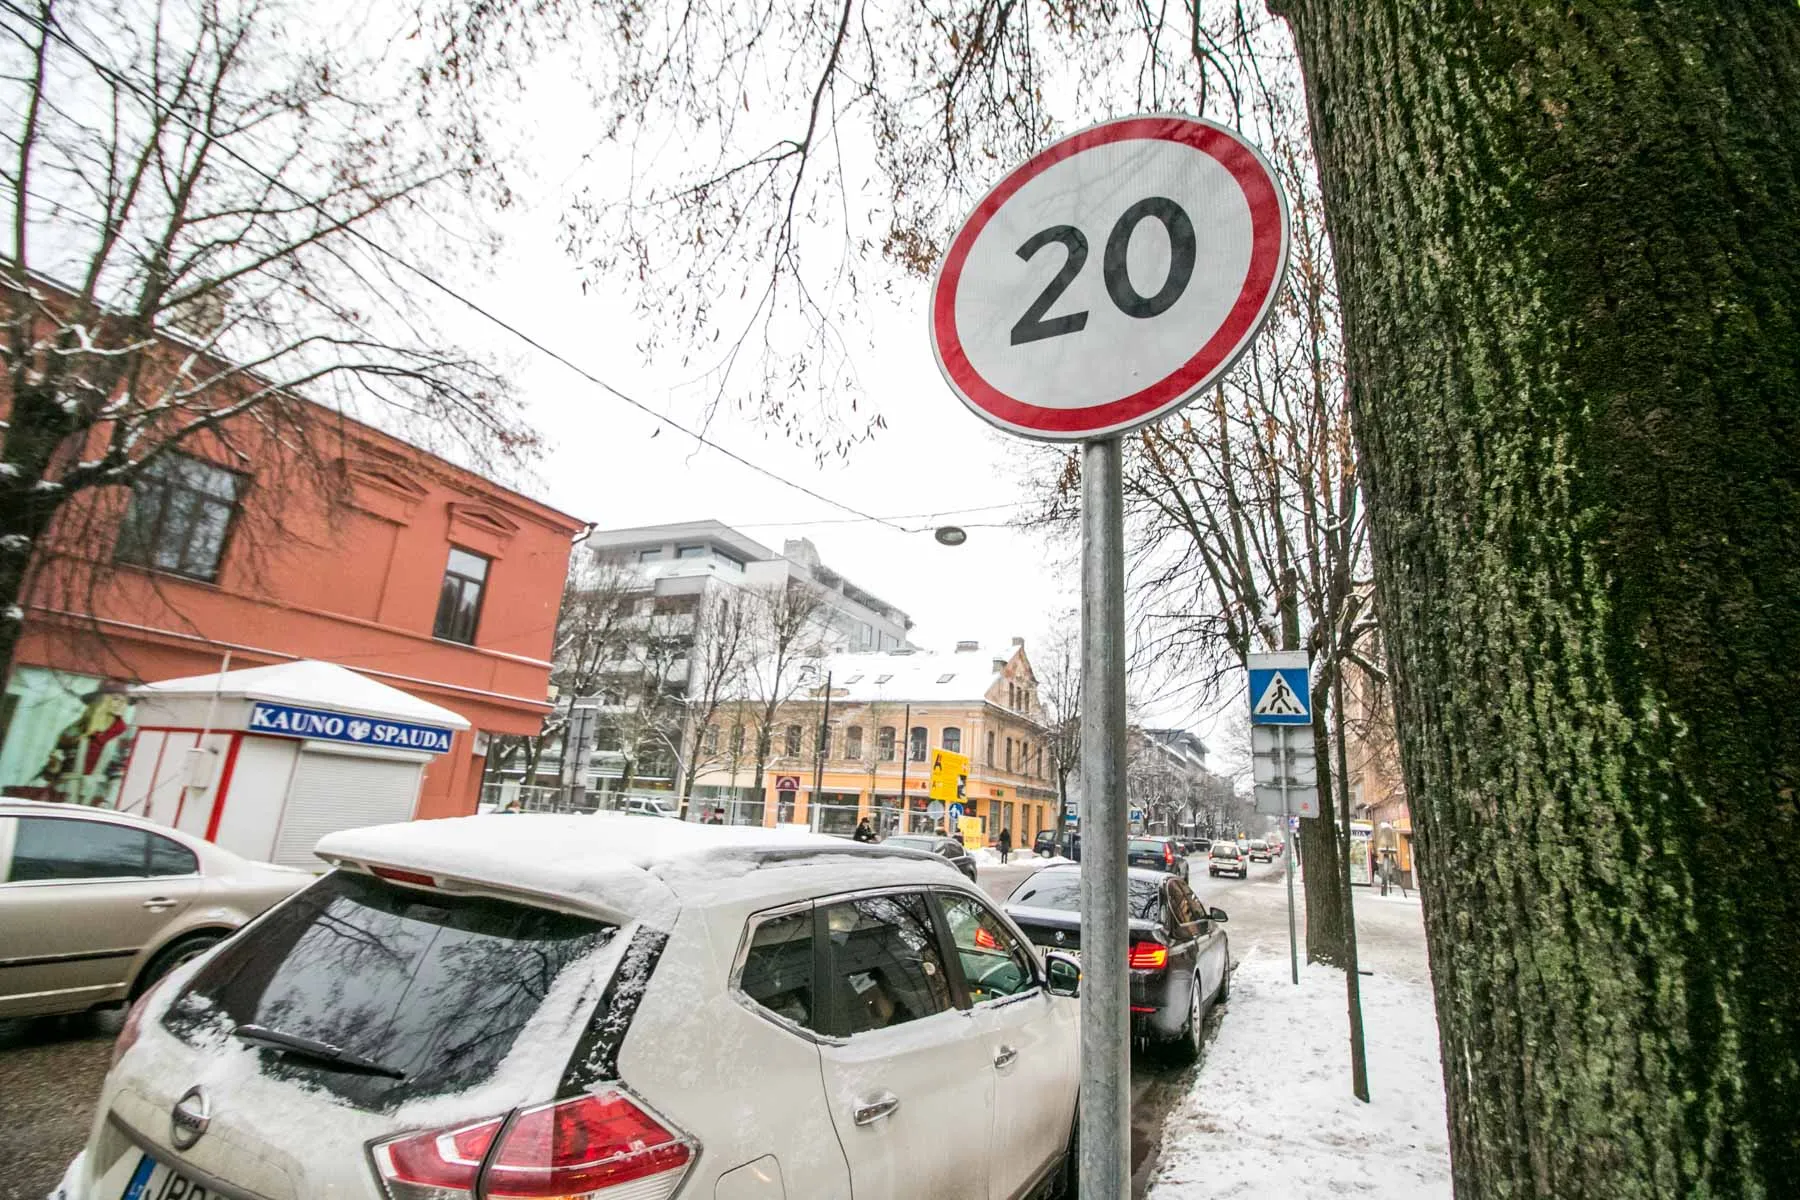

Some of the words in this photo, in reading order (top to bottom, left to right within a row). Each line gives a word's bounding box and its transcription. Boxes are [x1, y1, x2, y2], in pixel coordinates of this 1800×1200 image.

[1011, 196, 1197, 346] 20
[251, 707, 345, 736] KAUNO
[371, 723, 449, 750] SPAUDA
